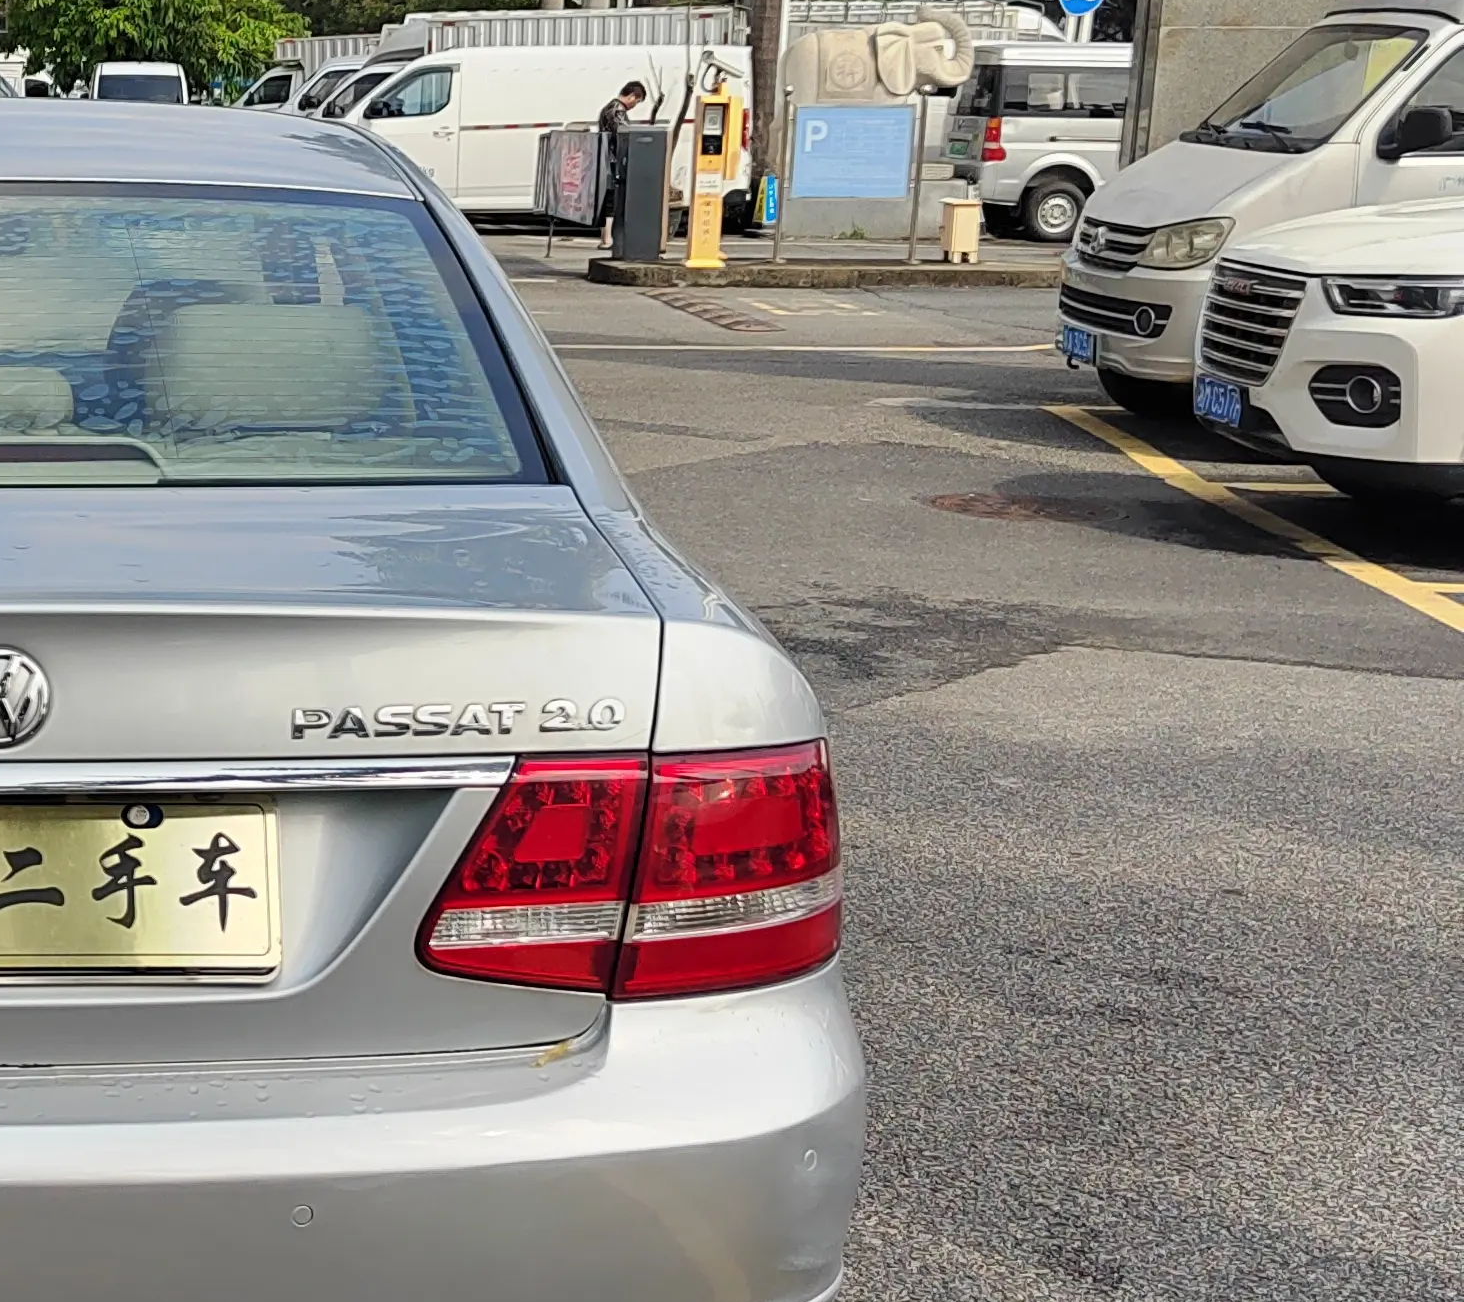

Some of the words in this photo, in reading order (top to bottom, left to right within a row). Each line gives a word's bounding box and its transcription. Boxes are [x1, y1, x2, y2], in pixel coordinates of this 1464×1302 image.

[803, 120, 829, 153] P
[291, 700, 526, 740] PASSAT
[538, 698, 626, 733] 2.0
